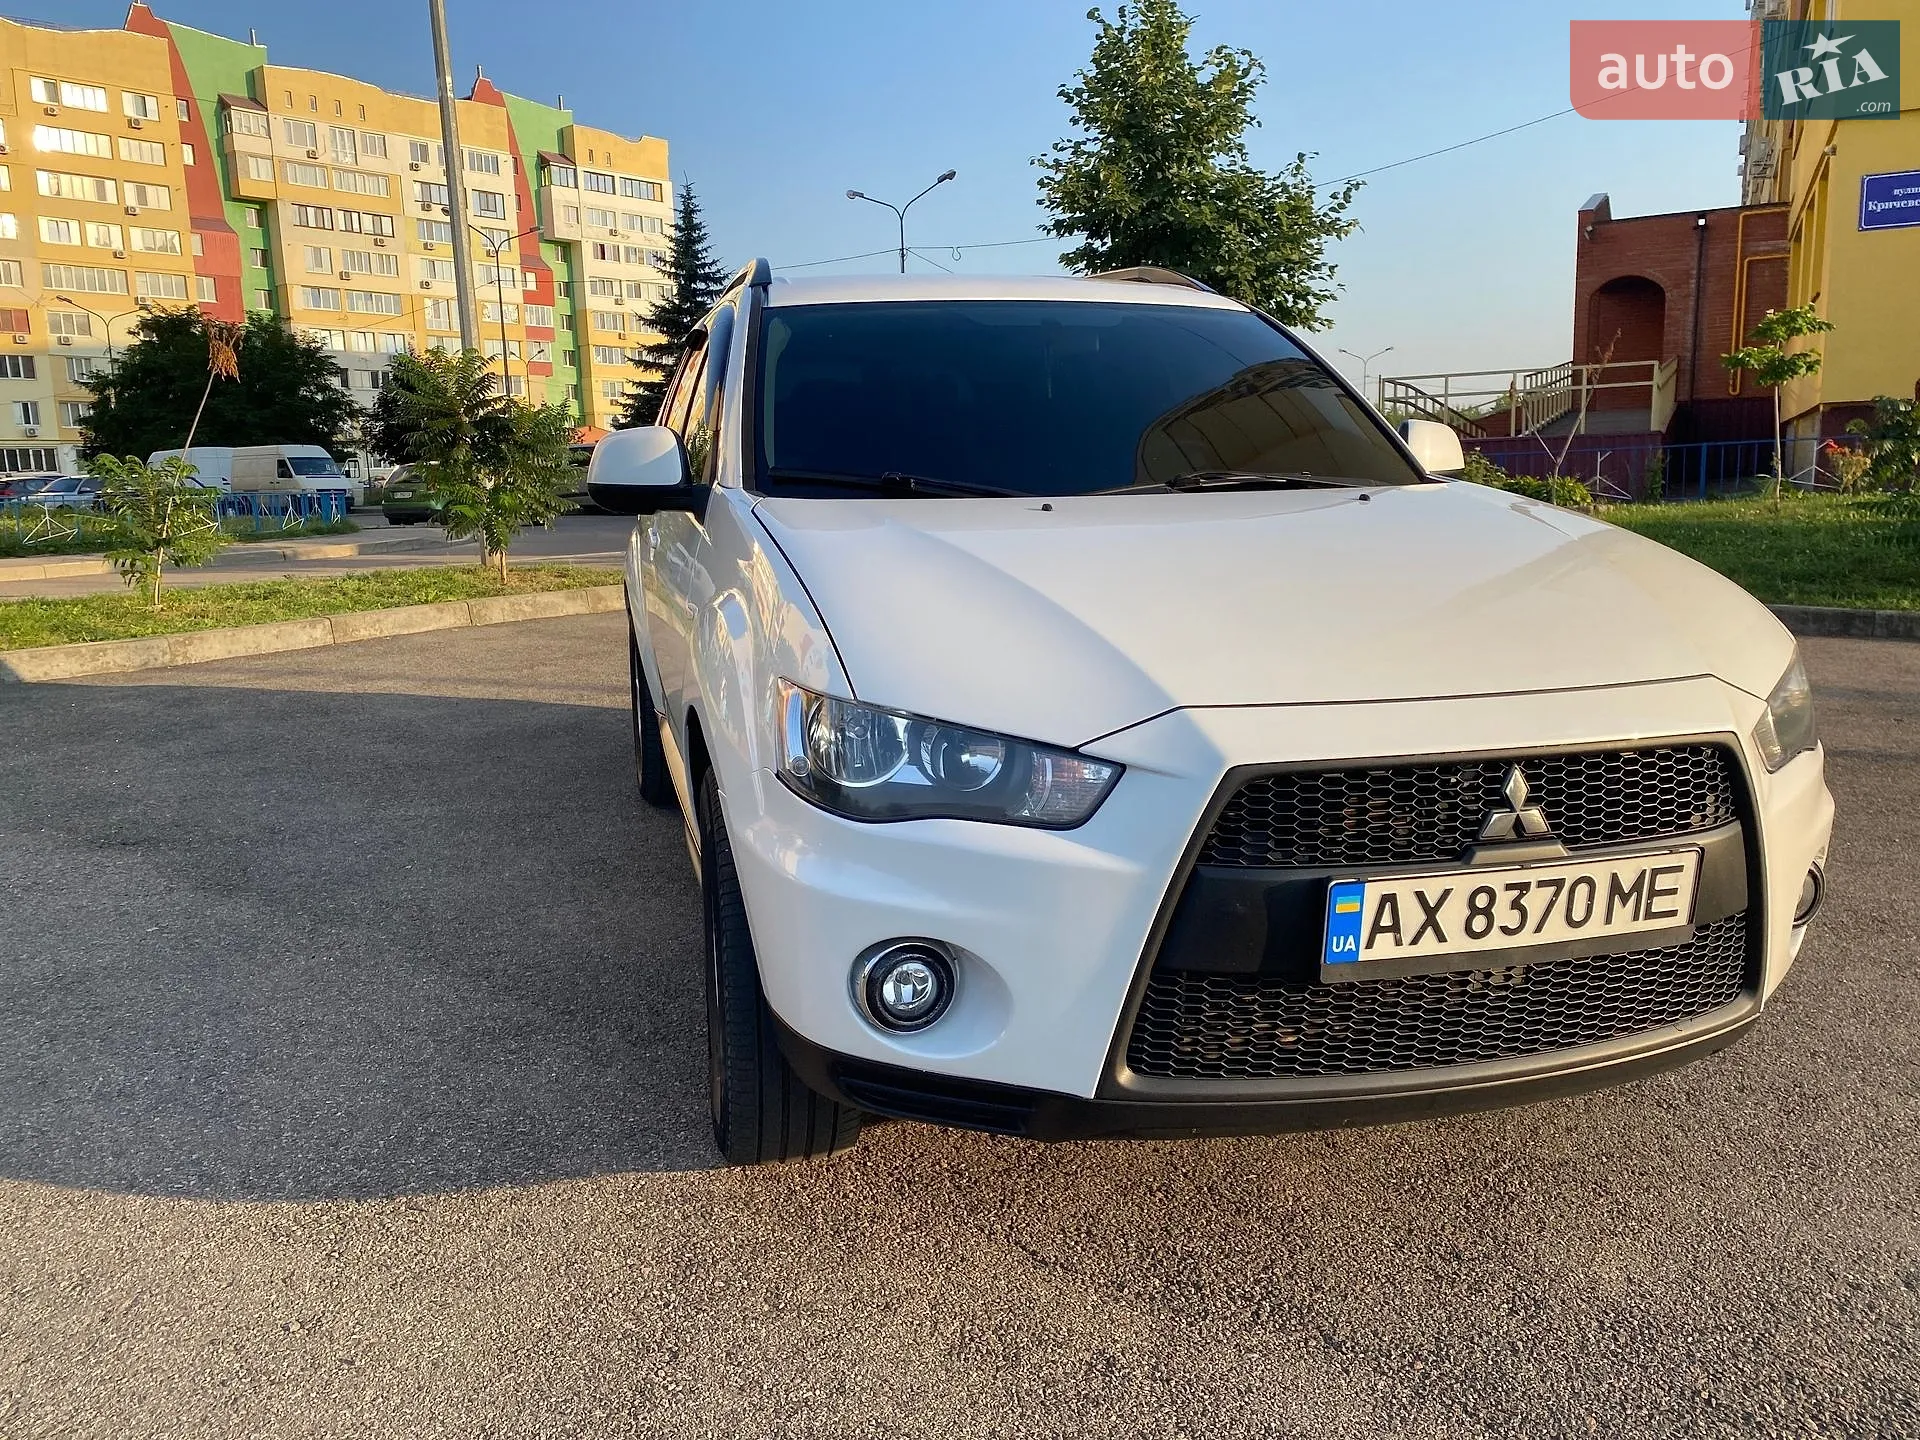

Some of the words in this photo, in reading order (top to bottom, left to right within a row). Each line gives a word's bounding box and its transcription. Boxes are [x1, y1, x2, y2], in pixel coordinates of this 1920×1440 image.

[1893, 187, 1920, 197] вули
[1365, 888, 1454, 949] AX
[1464, 875, 1597, 940] 8370
[1604, 864, 1685, 926] ME
[1332, 935, 1356, 953] UA
